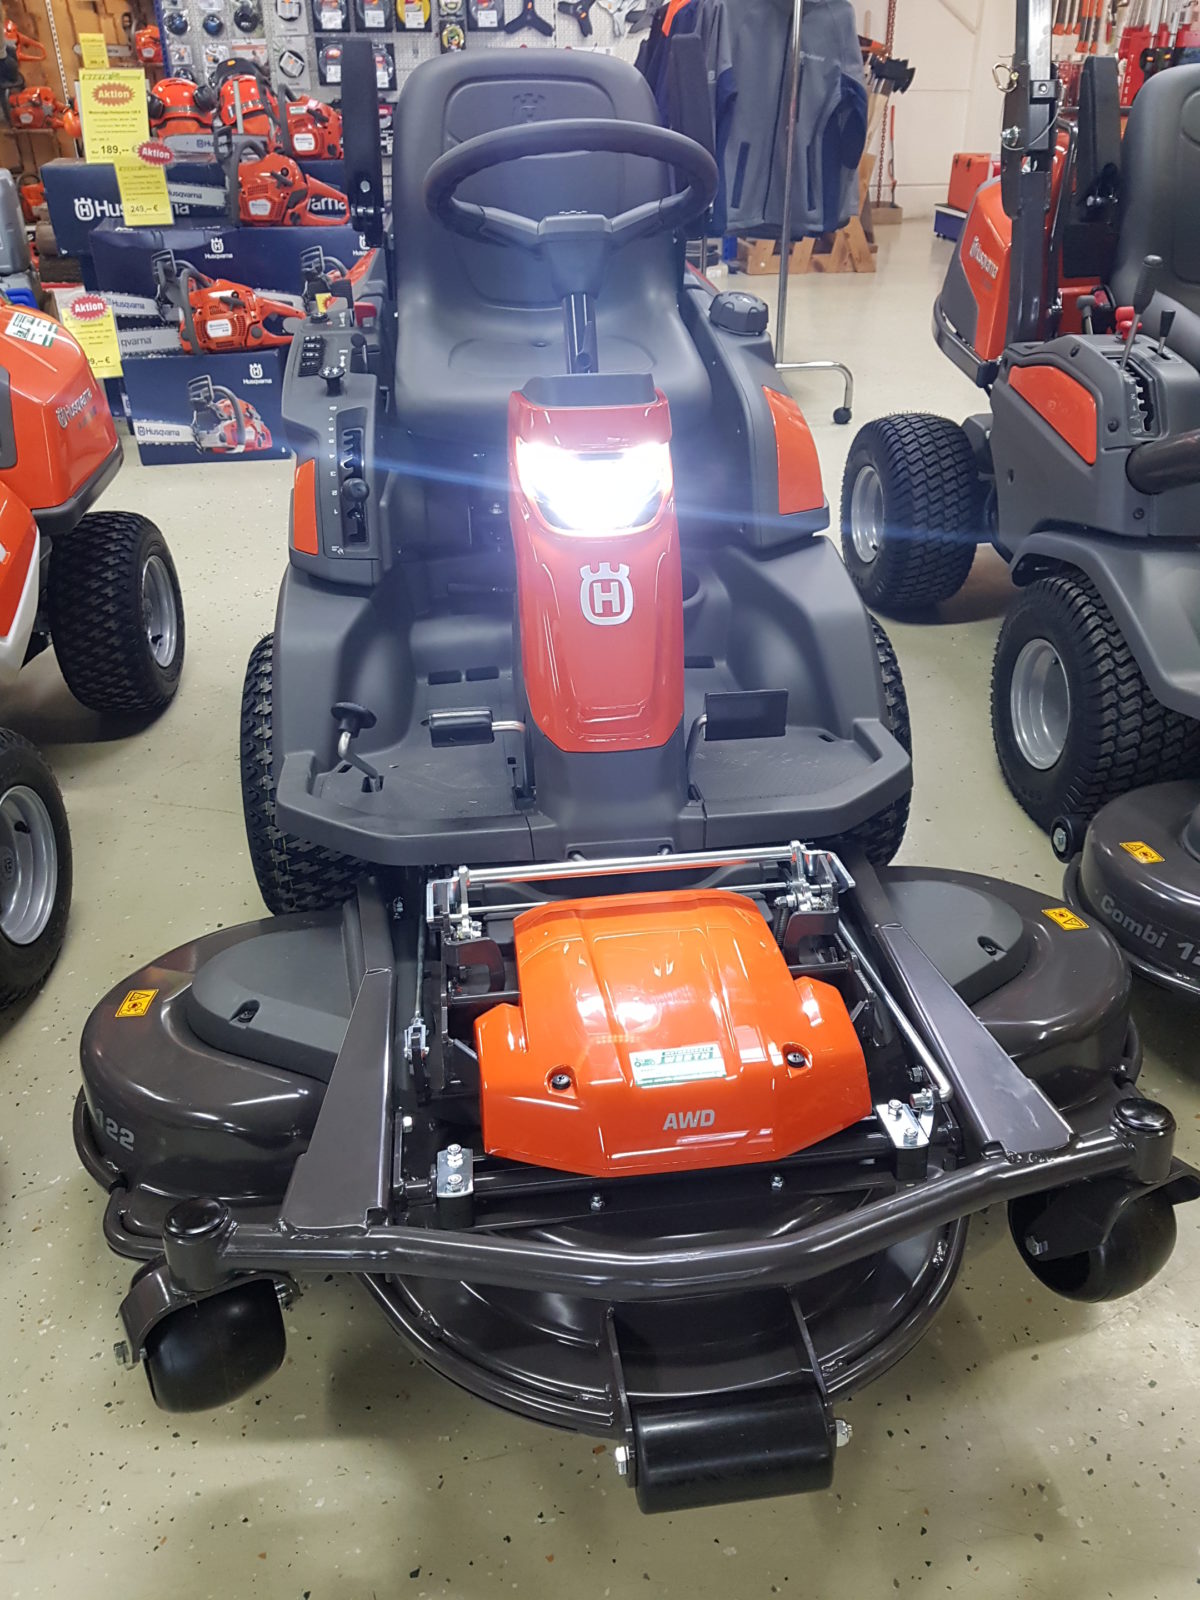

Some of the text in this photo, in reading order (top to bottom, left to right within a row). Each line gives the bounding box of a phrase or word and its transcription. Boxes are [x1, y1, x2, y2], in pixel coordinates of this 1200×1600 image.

[98, 90, 130, 99] Aktion
[142, 147, 170, 159] Aktion
[75, 302, 104, 313] Aktion
[112, 299, 145, 310] Husqvarna
[145, 428, 180, 438] Husqvarna
[1101, 895, 1168, 949] Combi
[663, 1109, 715, 1131] AWD
[95, 1108, 135, 1151] 122
